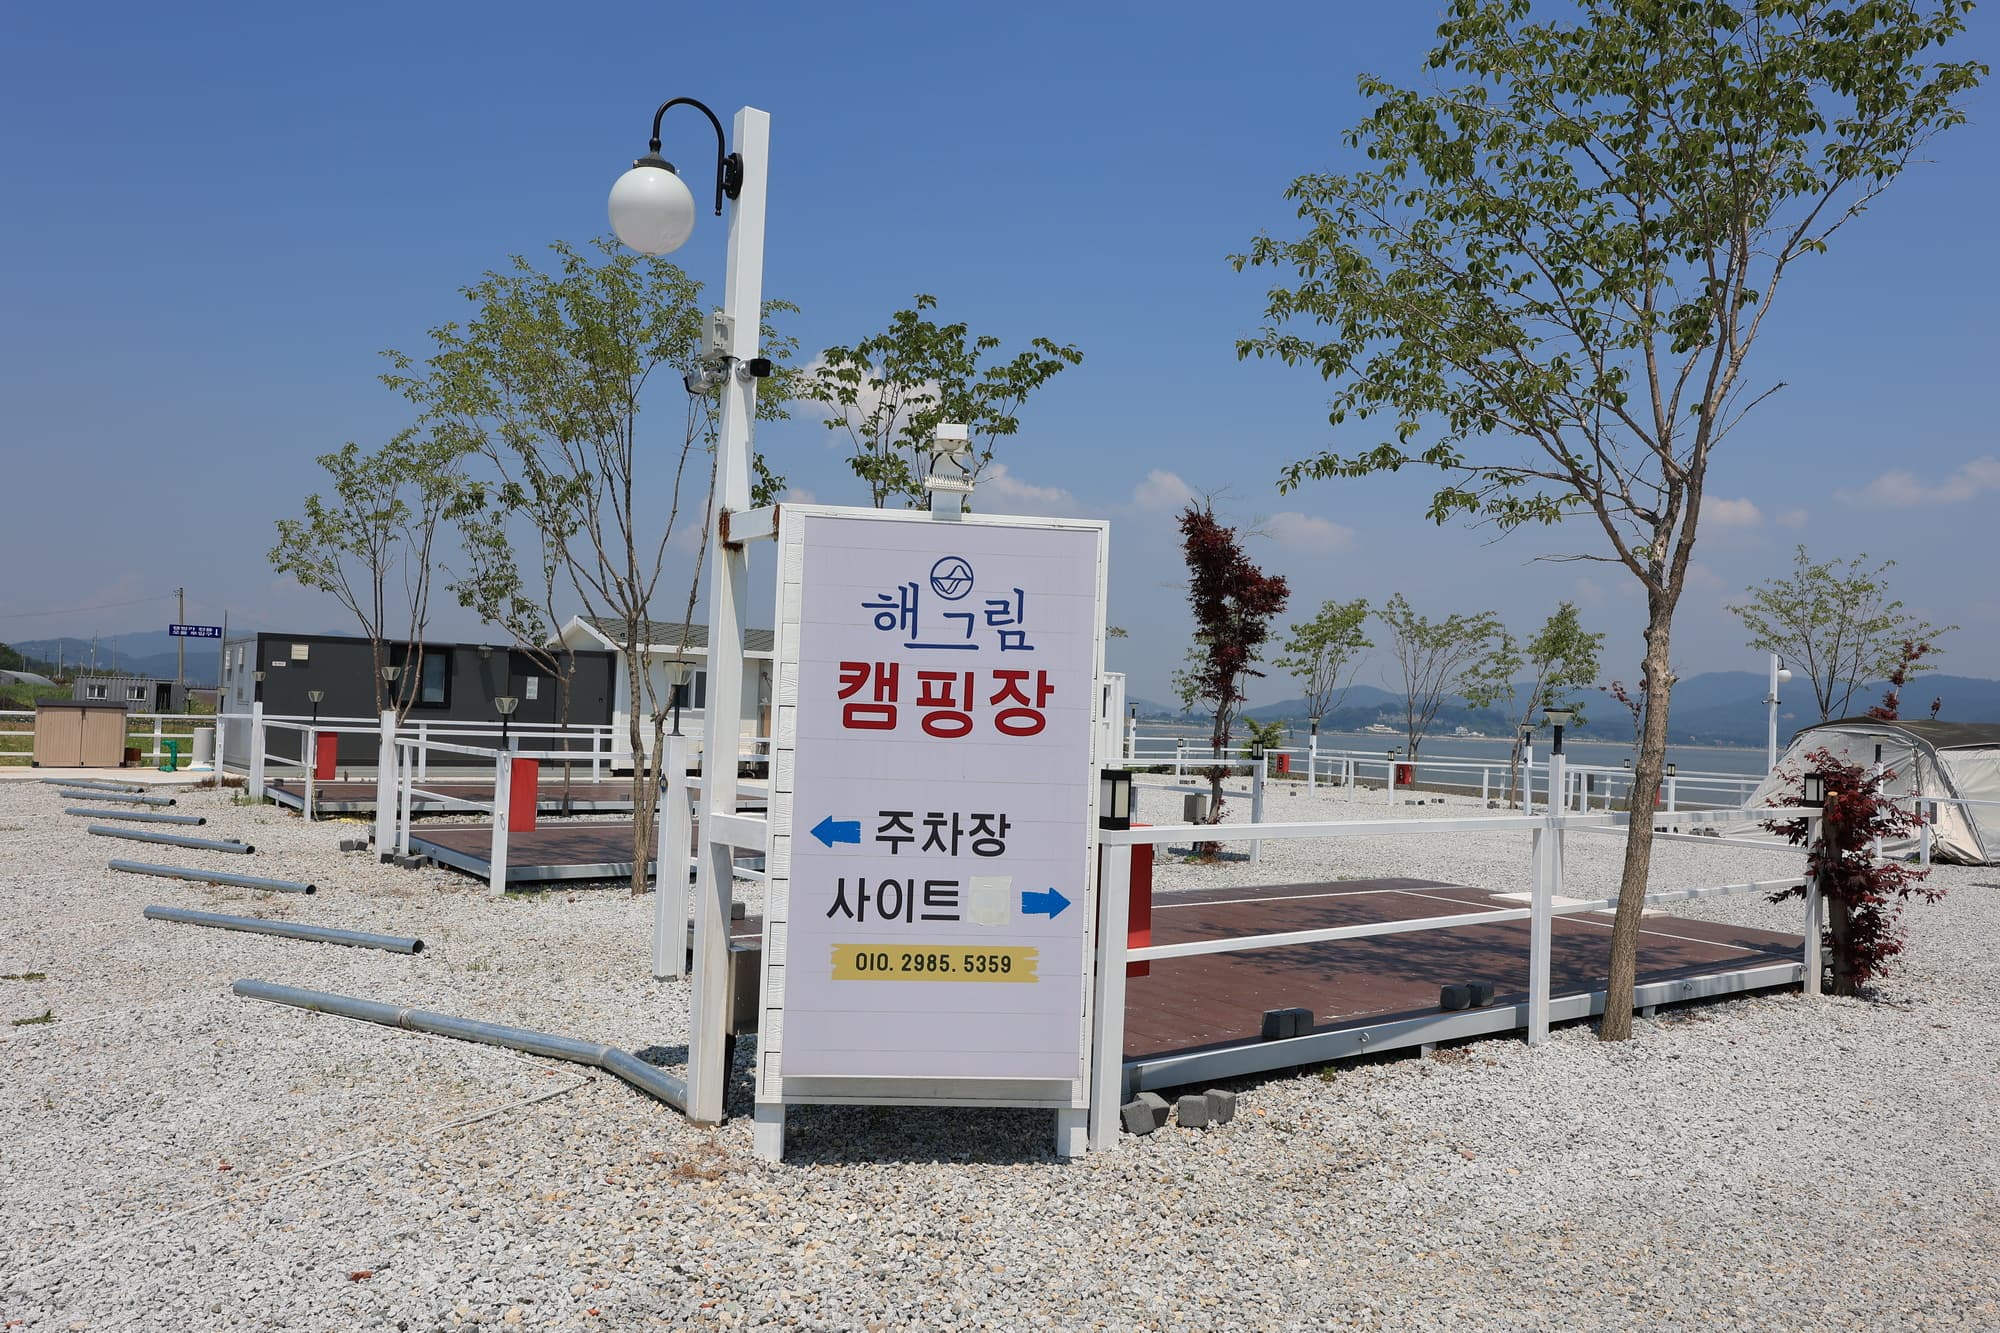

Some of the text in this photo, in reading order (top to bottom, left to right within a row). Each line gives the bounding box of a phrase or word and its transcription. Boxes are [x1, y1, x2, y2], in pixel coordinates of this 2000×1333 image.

[860, 581, 1035, 652] 해그림
[837, 661, 1055, 739] 캠핑장
[875, 810, 1012, 858] 주차장
[826, 877, 961, 924] 사이트
[963, 954, 1012, 974] 5359
